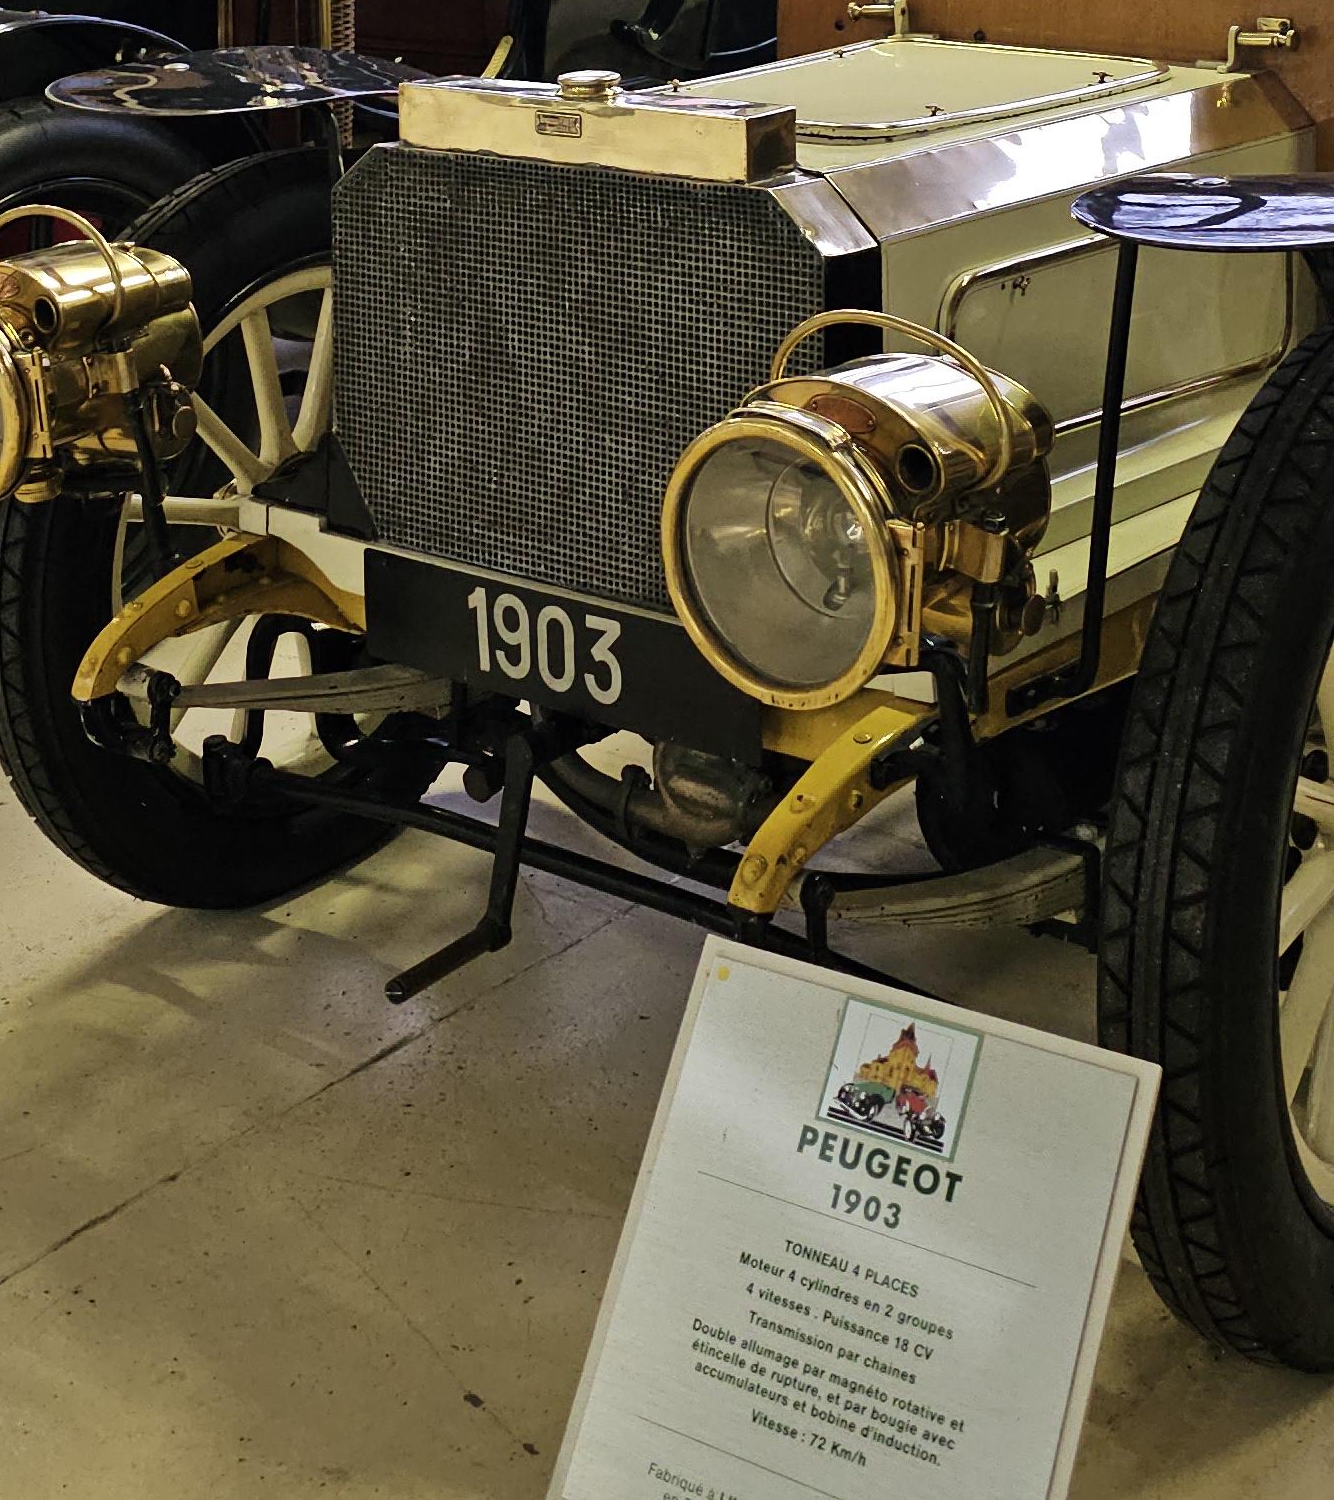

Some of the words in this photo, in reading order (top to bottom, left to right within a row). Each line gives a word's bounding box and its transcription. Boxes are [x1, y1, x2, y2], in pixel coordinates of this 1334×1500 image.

[467, 586, 622, 706] 1903
[796, 1123, 964, 1203] PEUGEOT
[830, 1182, 902, 1230] 1903
[738, 1251, 786, 1278] Moteur
[787, 1269, 798, 1283] 4
[800, 1275, 860, 1306] cylindres
[863, 1297, 881, 1314] en
[883, 1304, 894, 1319] 2
[897, 1310, 955, 1340] groupes
[784, 1239, 850, 1273] TONNEAU
[852, 1263, 861, 1277] 4
[865, 1268, 921, 1299] PLACES
[746, 1282, 755, 1296] 4
[758, 1288, 812, 1317] vitesses
[822, 1310, 890, 1346] Puissance
[894, 1337, 910, 1353] 18
[913, 1343, 934, 1360] CV
[748, 1310, 834, 1354] Transmission
[837, 1346, 861, 1365] par
[691, 1339, 747, 1370] étincelle
[750, 1360, 767, 1377] de
[770, 1371, 823, 1401] rupture,
[826, 1390, 842, 1406] et
[843, 1396, 868, 1415] par
[870, 1403, 919, 1436] bougie
[921, 1426, 957, 1451] avec
[692, 1317, 737, 1345] Double
[740, 1338, 800, 1370] allumage
[802, 1360, 827, 1380] par
[828, 1372, 888, 1403] magnéto
[892, 1395, 946, 1428] rotative
[949, 1417, 966, 1432] et
[694, 1361, 789, 1408] accumulateurs
[792, 1399, 808, 1414] et
[810, 1404, 857, 1434] bobine
[860, 1424, 941, 1467] d'induction.
[751, 1408, 799, 1440] Vitesse
[809, 1433, 827, 1452] 72
[830, 1440, 867, 1467] Km/h
[647, 1462, 704, 1496] Fabriqué
